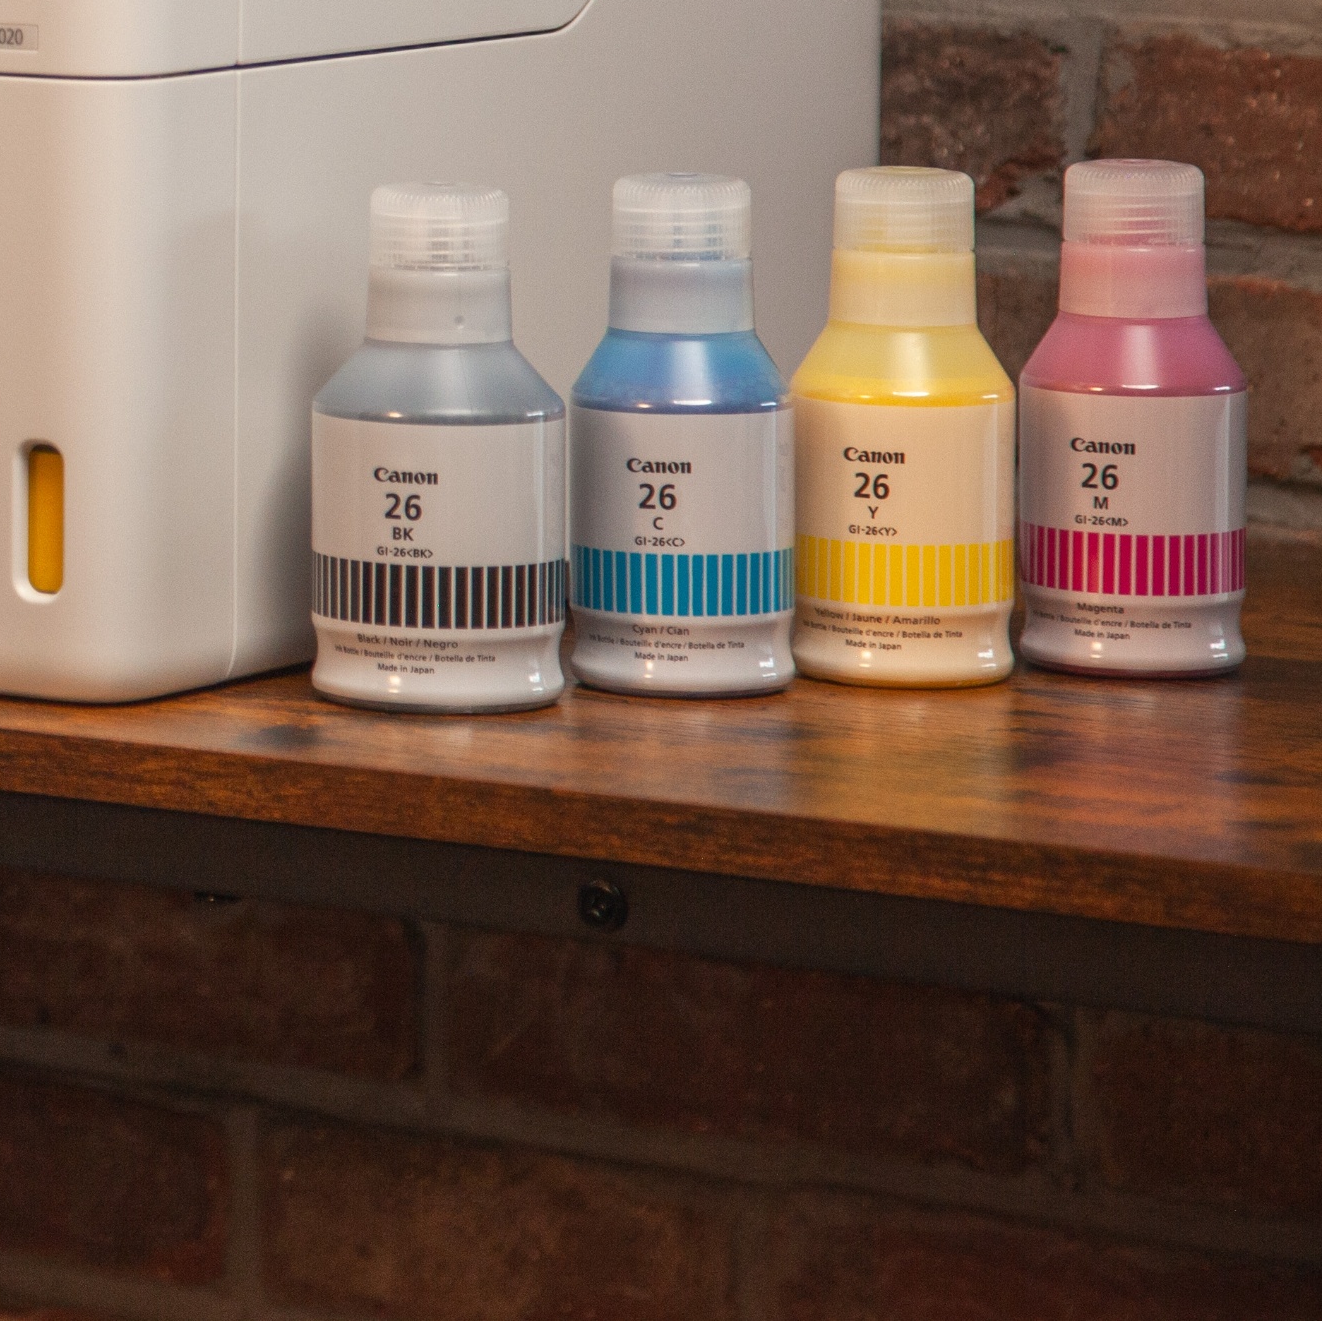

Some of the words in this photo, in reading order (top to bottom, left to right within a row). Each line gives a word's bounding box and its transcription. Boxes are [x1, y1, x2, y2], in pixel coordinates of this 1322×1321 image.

[1071, 437, 1136, 455] Canon
[843, 447, 905, 464] Canon
[626, 458, 692, 474] Canon
[374, 467, 439, 485] Canon
[1081, 463, 1119, 490] 26
[854, 472, 890, 499] 26
[638, 483, 677, 510] 26
[1093, 496, 1109, 510] M
[384, 493, 422, 521] 26
[868, 506, 879, 519] Y
[653, 517, 664, 530] C
[1075, 514, 1129, 527] GI-26<M>
[392, 528, 414, 541] BK
[848, 524, 898, 536] GI-26<Y>
[635, 536, 685, 547] GI-26<C>
[377, 546, 433, 559] GI-26<BK>
[1077, 603, 1124, 614] Magenta
[814, 607, 843, 620] Yellow
[852, 613, 882, 624] Jaune
[893, 616, 940, 625] Amarillo
[632, 624, 657, 637] Cyan
[667, 626, 690, 636] Cian
[1162, 621, 1172, 629] de
[1174, 621, 1192, 629] Tinta
[866, 629, 894, 637] d'encre
[902, 630, 931, 639] Botella
[933, 630, 942, 638] de
[945, 630, 963, 638] Tinta
[1075, 629, 1095, 638] Made
[1097, 630, 1105, 638] in
[1107, 631, 1130, 641] Japan
[357, 633, 381, 645] Black
[390, 637, 413, 647] Noir
[424, 640, 458, 650] Negro
[654, 641, 682, 649] d'encre
[688, 642, 715, 650] Botella
[716, 641, 726, 649] de
[845, 639, 867, 648] Made
[869, 640, 876, 649] in
[879, 640, 902, 651] Japan
[397, 652, 427, 662] d'encre
[435, 654, 463, 663] Botella
[465, 654, 475, 663] de
[478, 654, 495, 663] Tinta
[635, 652, 655, 660] Made
[658, 652, 665, 661] in
[667, 653, 689, 663] Japan
[377, 663, 398, 672] Made
[400, 663, 408, 672] in
[410, 664, 435, 675] Japan
